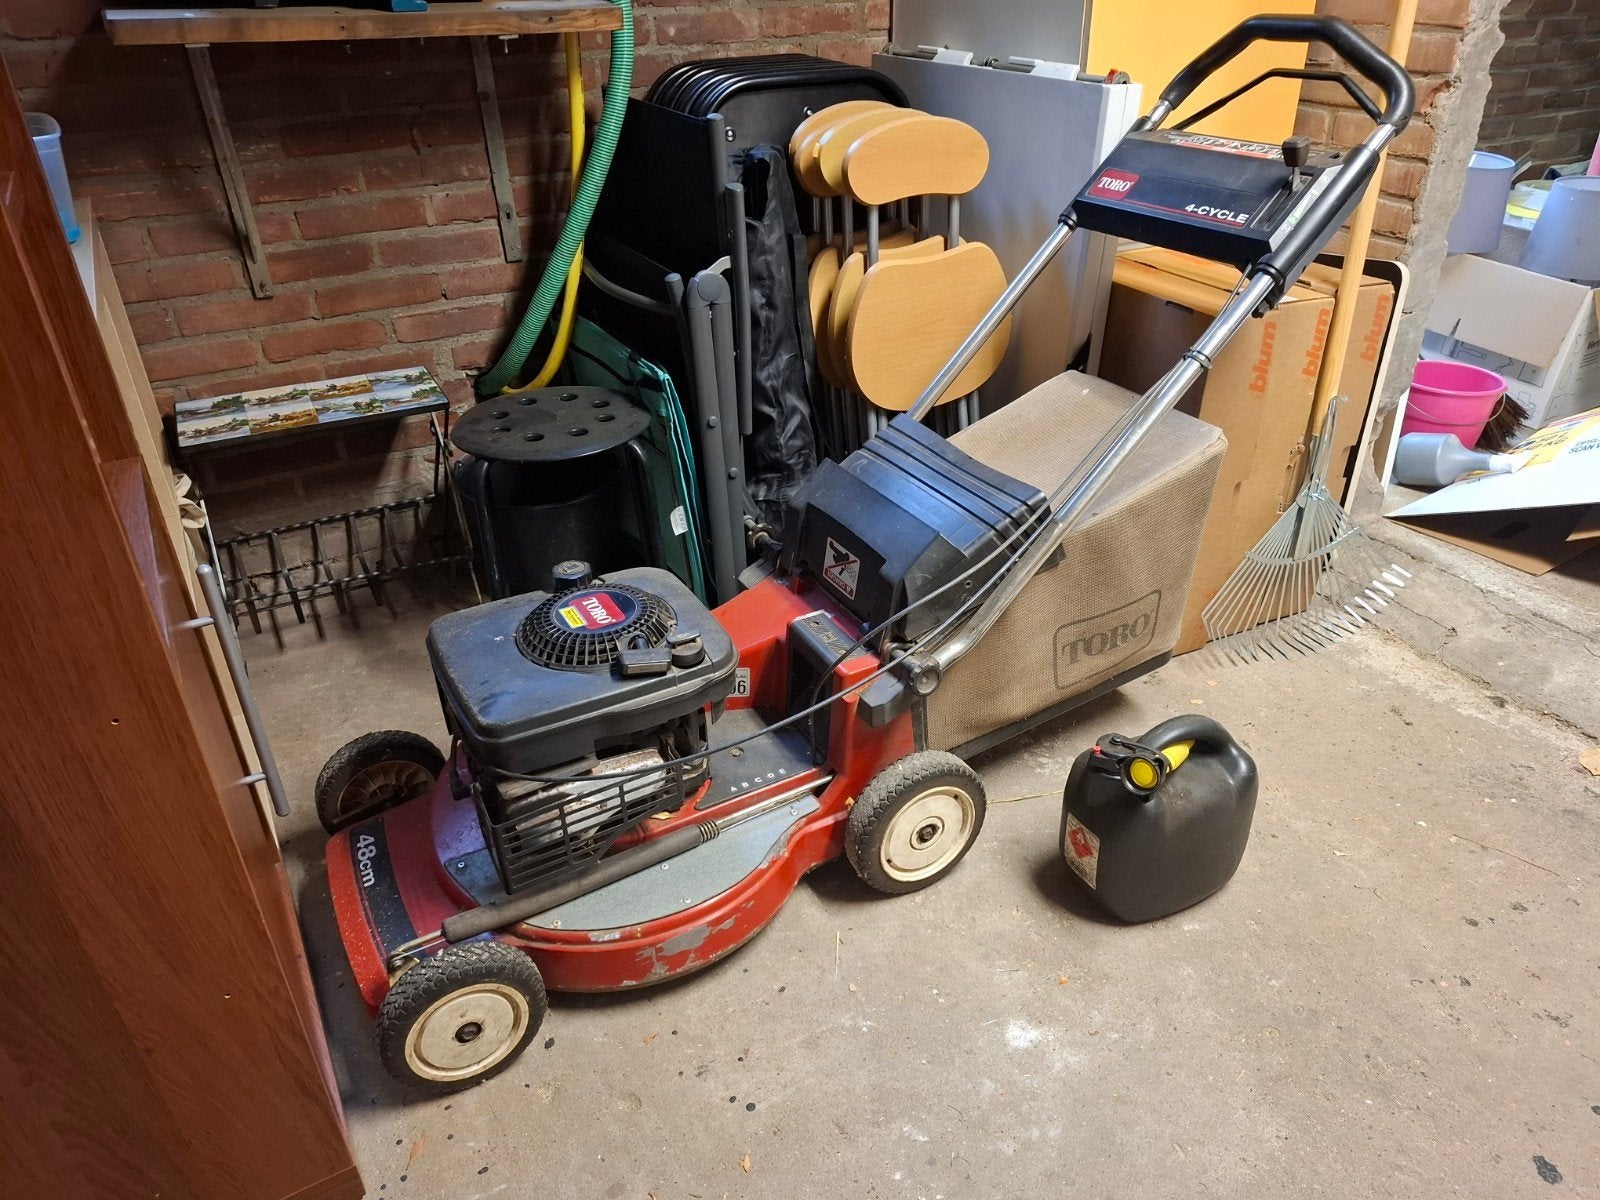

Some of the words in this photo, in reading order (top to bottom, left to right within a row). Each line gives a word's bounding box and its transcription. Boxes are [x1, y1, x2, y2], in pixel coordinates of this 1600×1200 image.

[1097, 176, 1131, 192] TORO
[1184, 203, 1250, 225] 4-CYCLE
[1302, 307, 1331, 378] blum
[1360, 294, 1392, 362] blum
[1249, 321, 1277, 393] blum
[582, 597, 613, 624] TORO
[1061, 613, 1151, 667] TORO
[357, 835, 377, 887] 48cm
